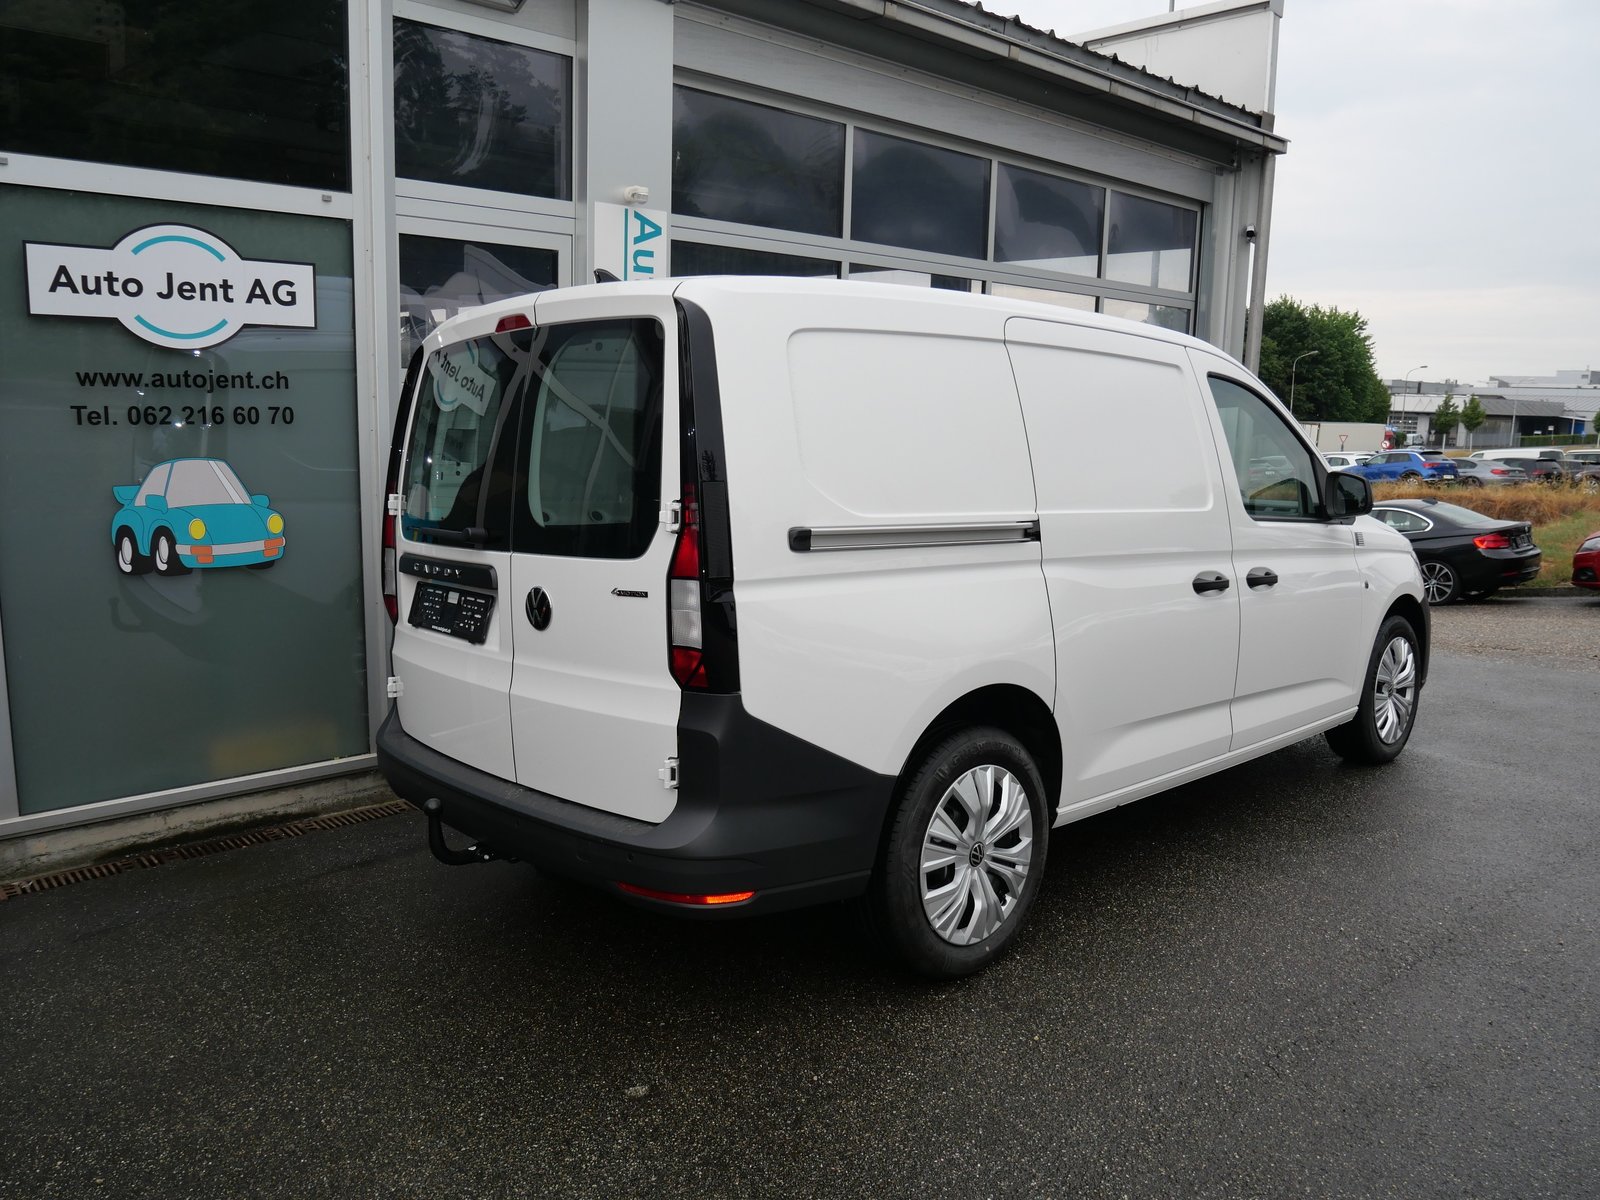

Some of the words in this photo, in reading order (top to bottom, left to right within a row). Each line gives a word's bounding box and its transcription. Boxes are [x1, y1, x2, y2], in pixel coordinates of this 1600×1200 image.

[633, 210, 662, 280] Au
[48, 264, 144, 298] Auto
[156, 272, 234, 303] Jent
[245, 278, 297, 307] AG
[75, 370, 290, 393] www.autojent.ch
[70, 405, 118, 426] Tel.
[127, 405, 172, 426] 062
[182, 406, 225, 426] 216
[233, 406, 260, 425] 60
[267, 406, 295, 425] 70
[413, 562, 463, 579] CADDY
